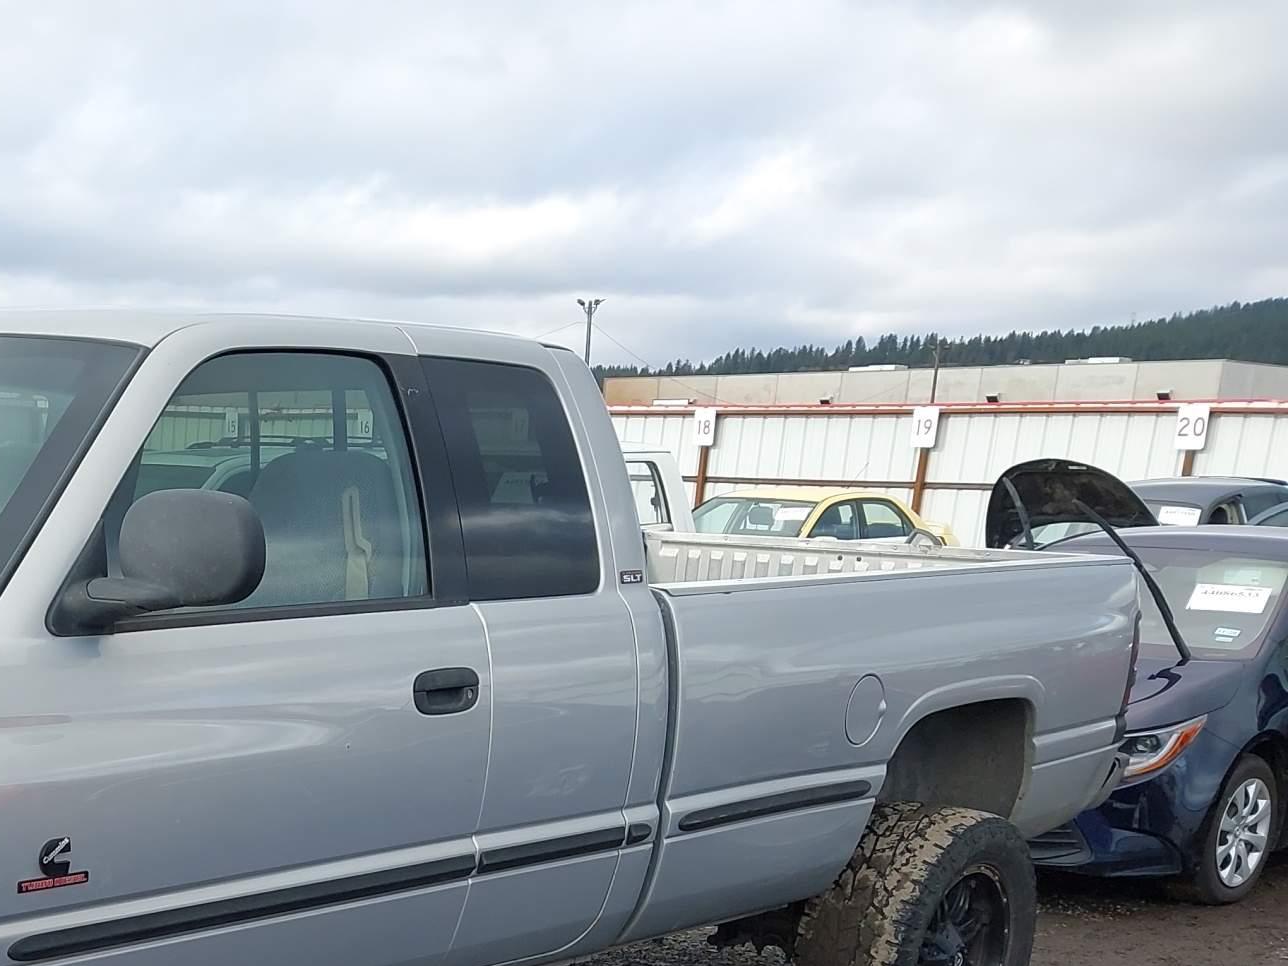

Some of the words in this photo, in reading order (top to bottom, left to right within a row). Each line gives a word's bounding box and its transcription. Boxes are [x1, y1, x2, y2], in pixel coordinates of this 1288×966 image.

[361, 421, 370, 433] 16
[698, 420, 710, 435] 18
[916, 419, 932, 436] 19
[1178, 417, 1205, 436] 20
[623, 574, 642, 582] SLT
